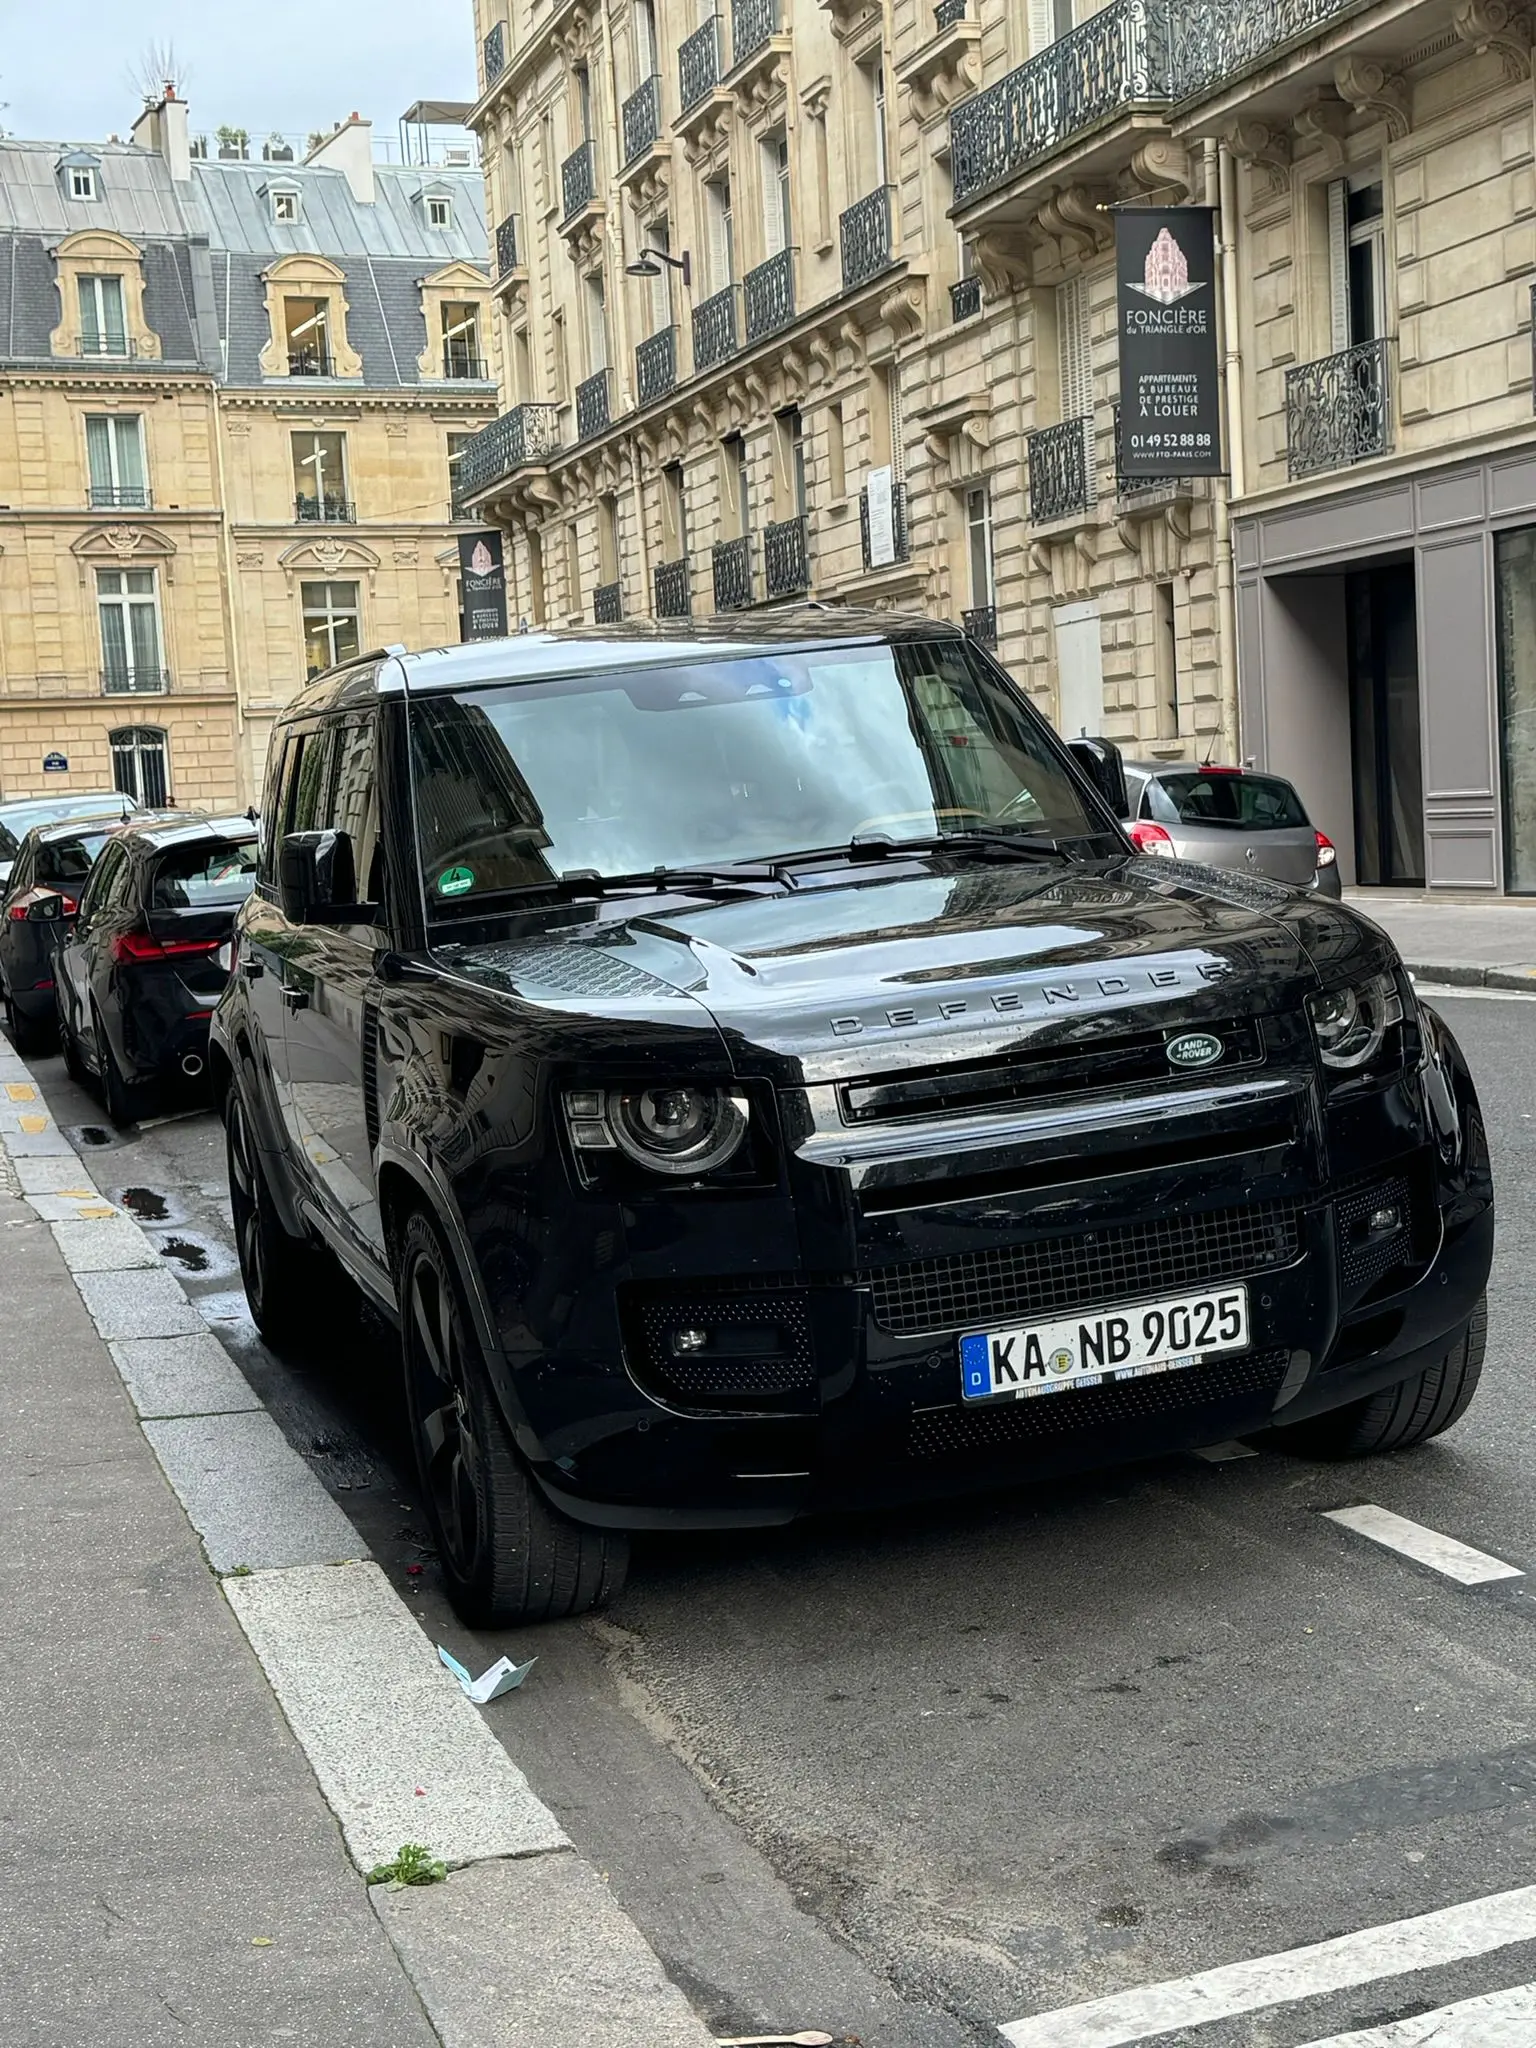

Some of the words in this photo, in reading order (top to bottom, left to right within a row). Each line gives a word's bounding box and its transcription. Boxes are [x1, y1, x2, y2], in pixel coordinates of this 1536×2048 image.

[1126, 306, 1207, 325] FONCIÈRE
[1126, 326, 1137, 335] du
[1139, 325, 1184, 334] TRIANGLE
[1186, 325, 1207, 334] d'OR
[1138, 374, 1198, 384] APPARTEMENTS
[1138, 385, 1145, 394] &
[1150, 384, 1198, 394] BUREAUX
[1139, 395, 1152, 404] DE
[1155, 394, 1199, 404] PRESTIGE
[1154, 405, 1198, 416] LOUER
[1131, 434, 1144, 448] 01
[1146, 434, 1161, 447] 49
[1163, 434, 1178, 447] 52
[1180, 433, 1194, 446] 88
[1196, 433, 1211, 446] 88
[450, 868, 460, 881] 4
[829, 960, 1233, 1036] DEFENDER
[991, 1332, 1047, 1385] KA
[1078, 1317, 1132, 1369] NB
[1142, 1295, 1241, 1357] 9025
[971, 1371, 982, 1386] D
